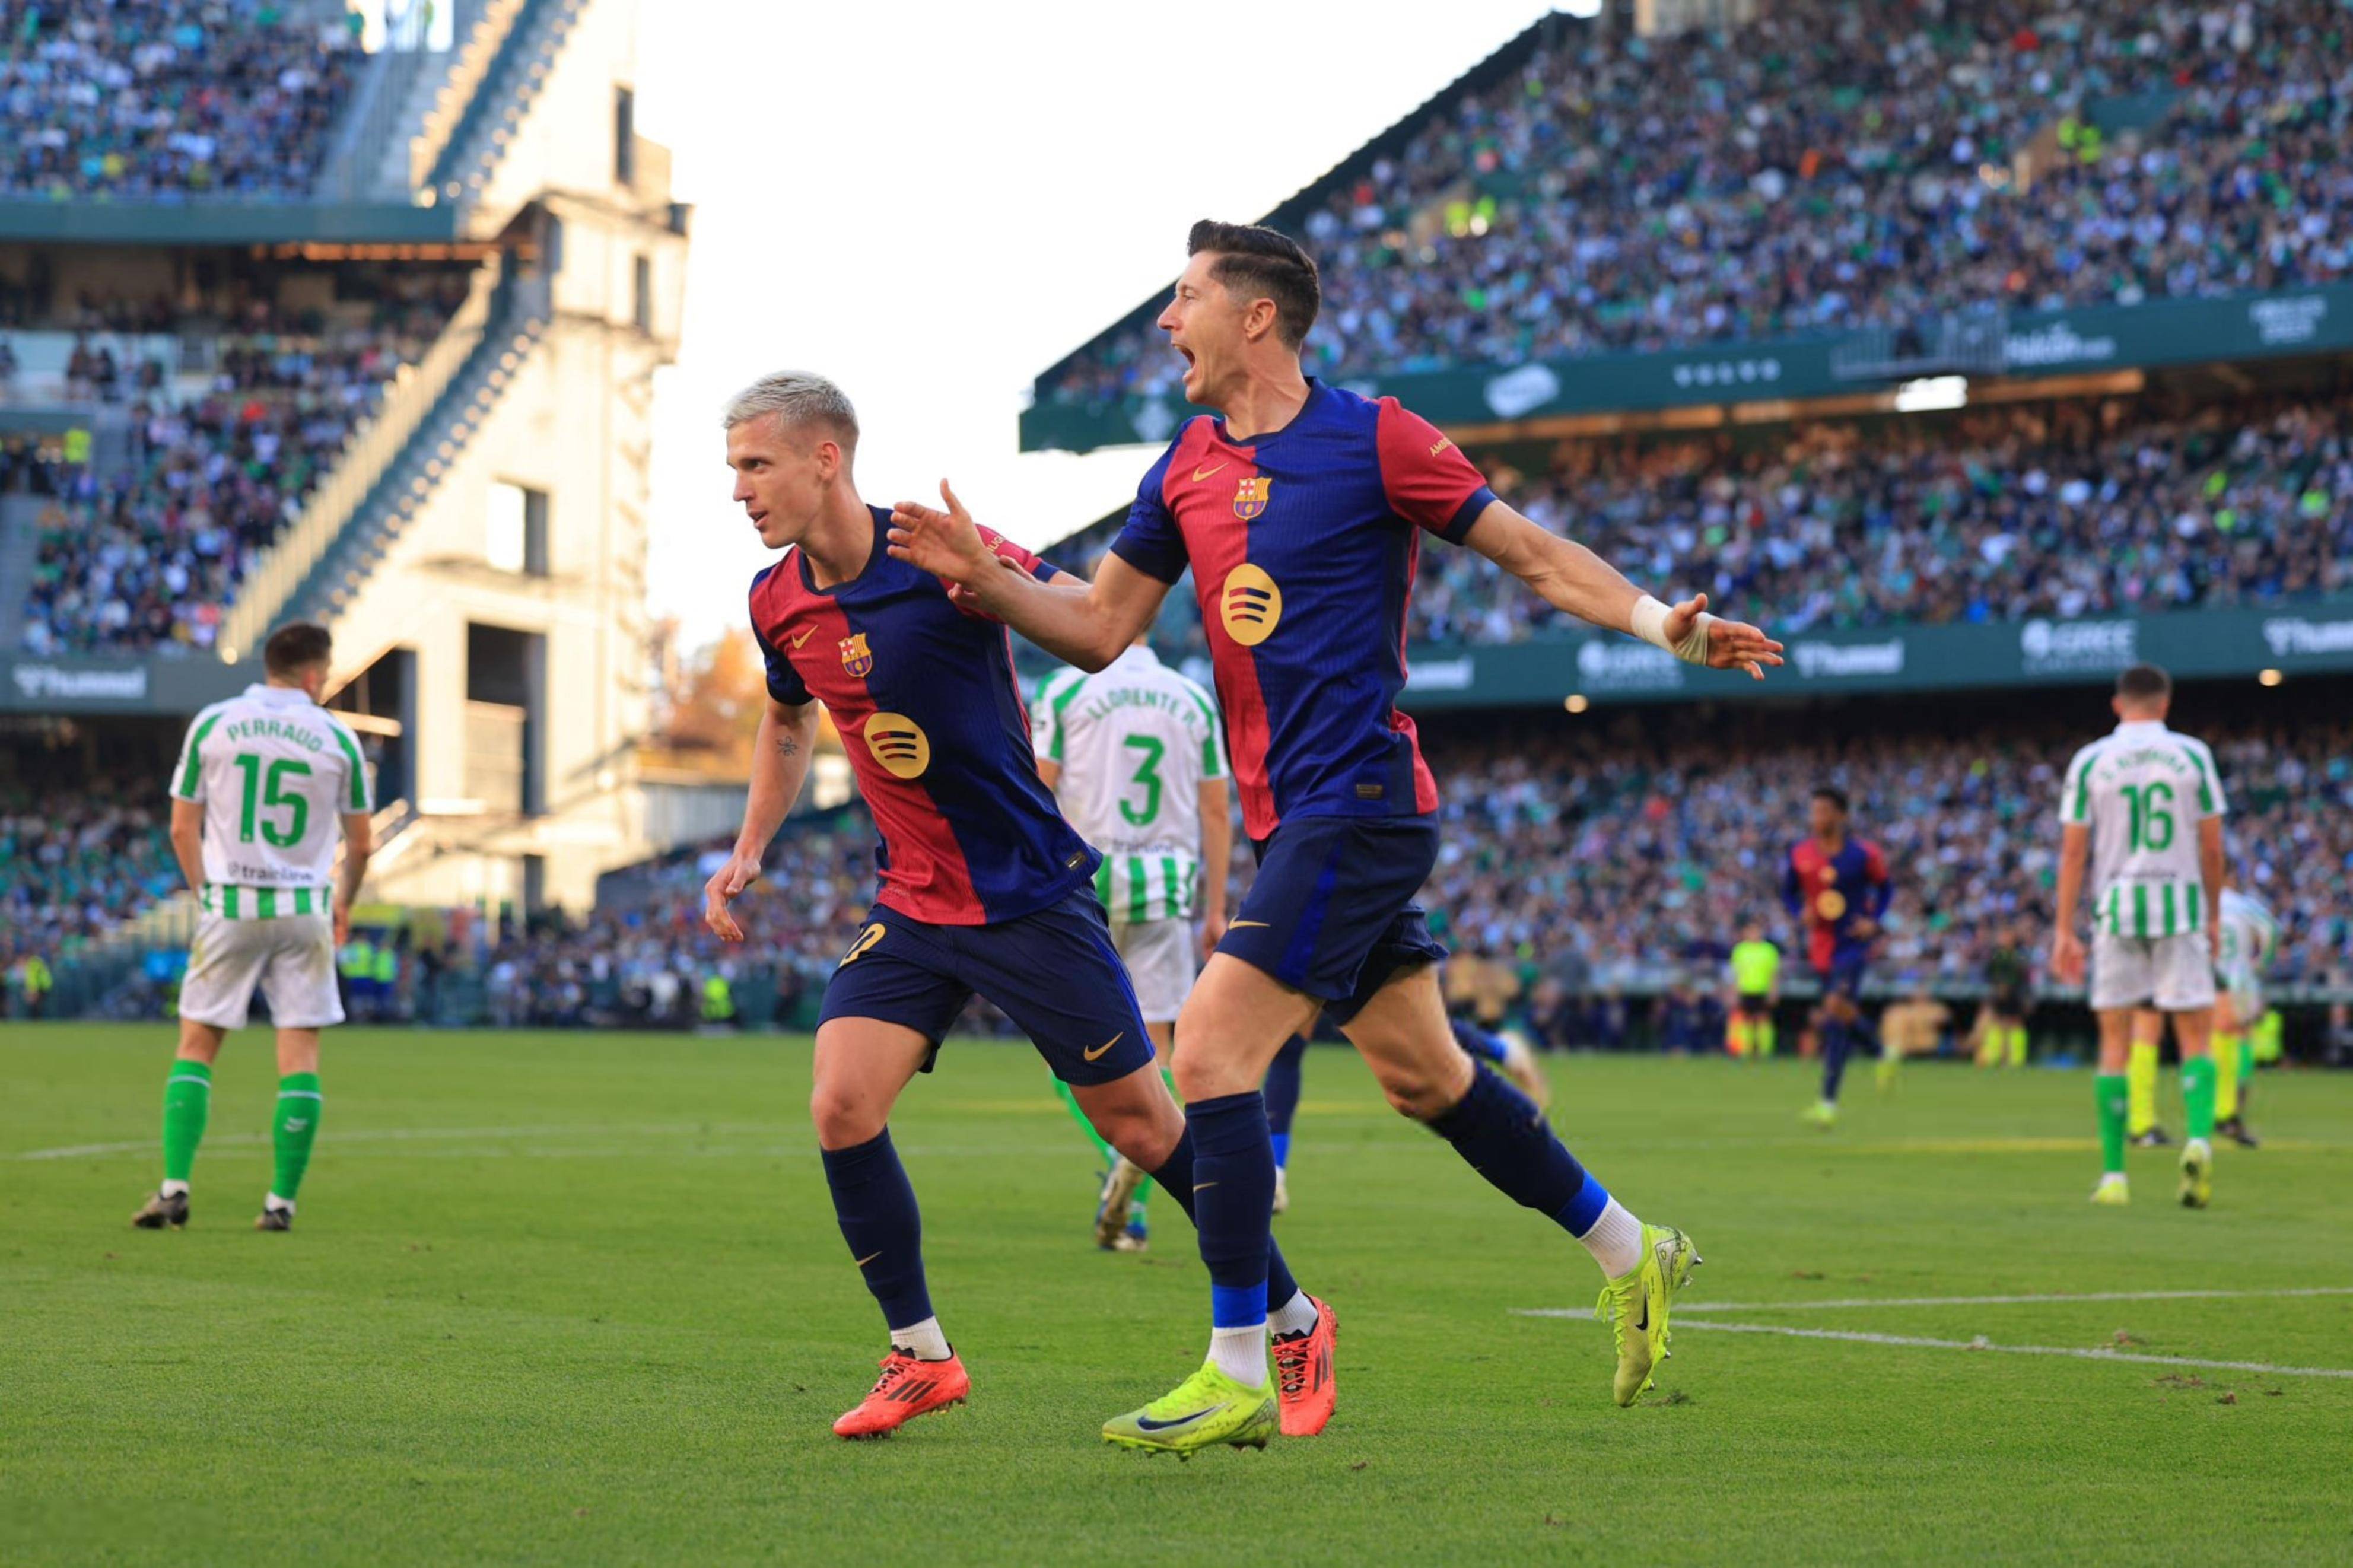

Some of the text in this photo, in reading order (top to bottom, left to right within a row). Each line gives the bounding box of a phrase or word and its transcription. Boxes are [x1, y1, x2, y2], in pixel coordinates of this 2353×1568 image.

[227, 718, 323, 752] PERRAUD
[234, 753, 312, 848] 15
[1119, 733, 1165, 826] 3
[2120, 782, 2174, 854] 16
